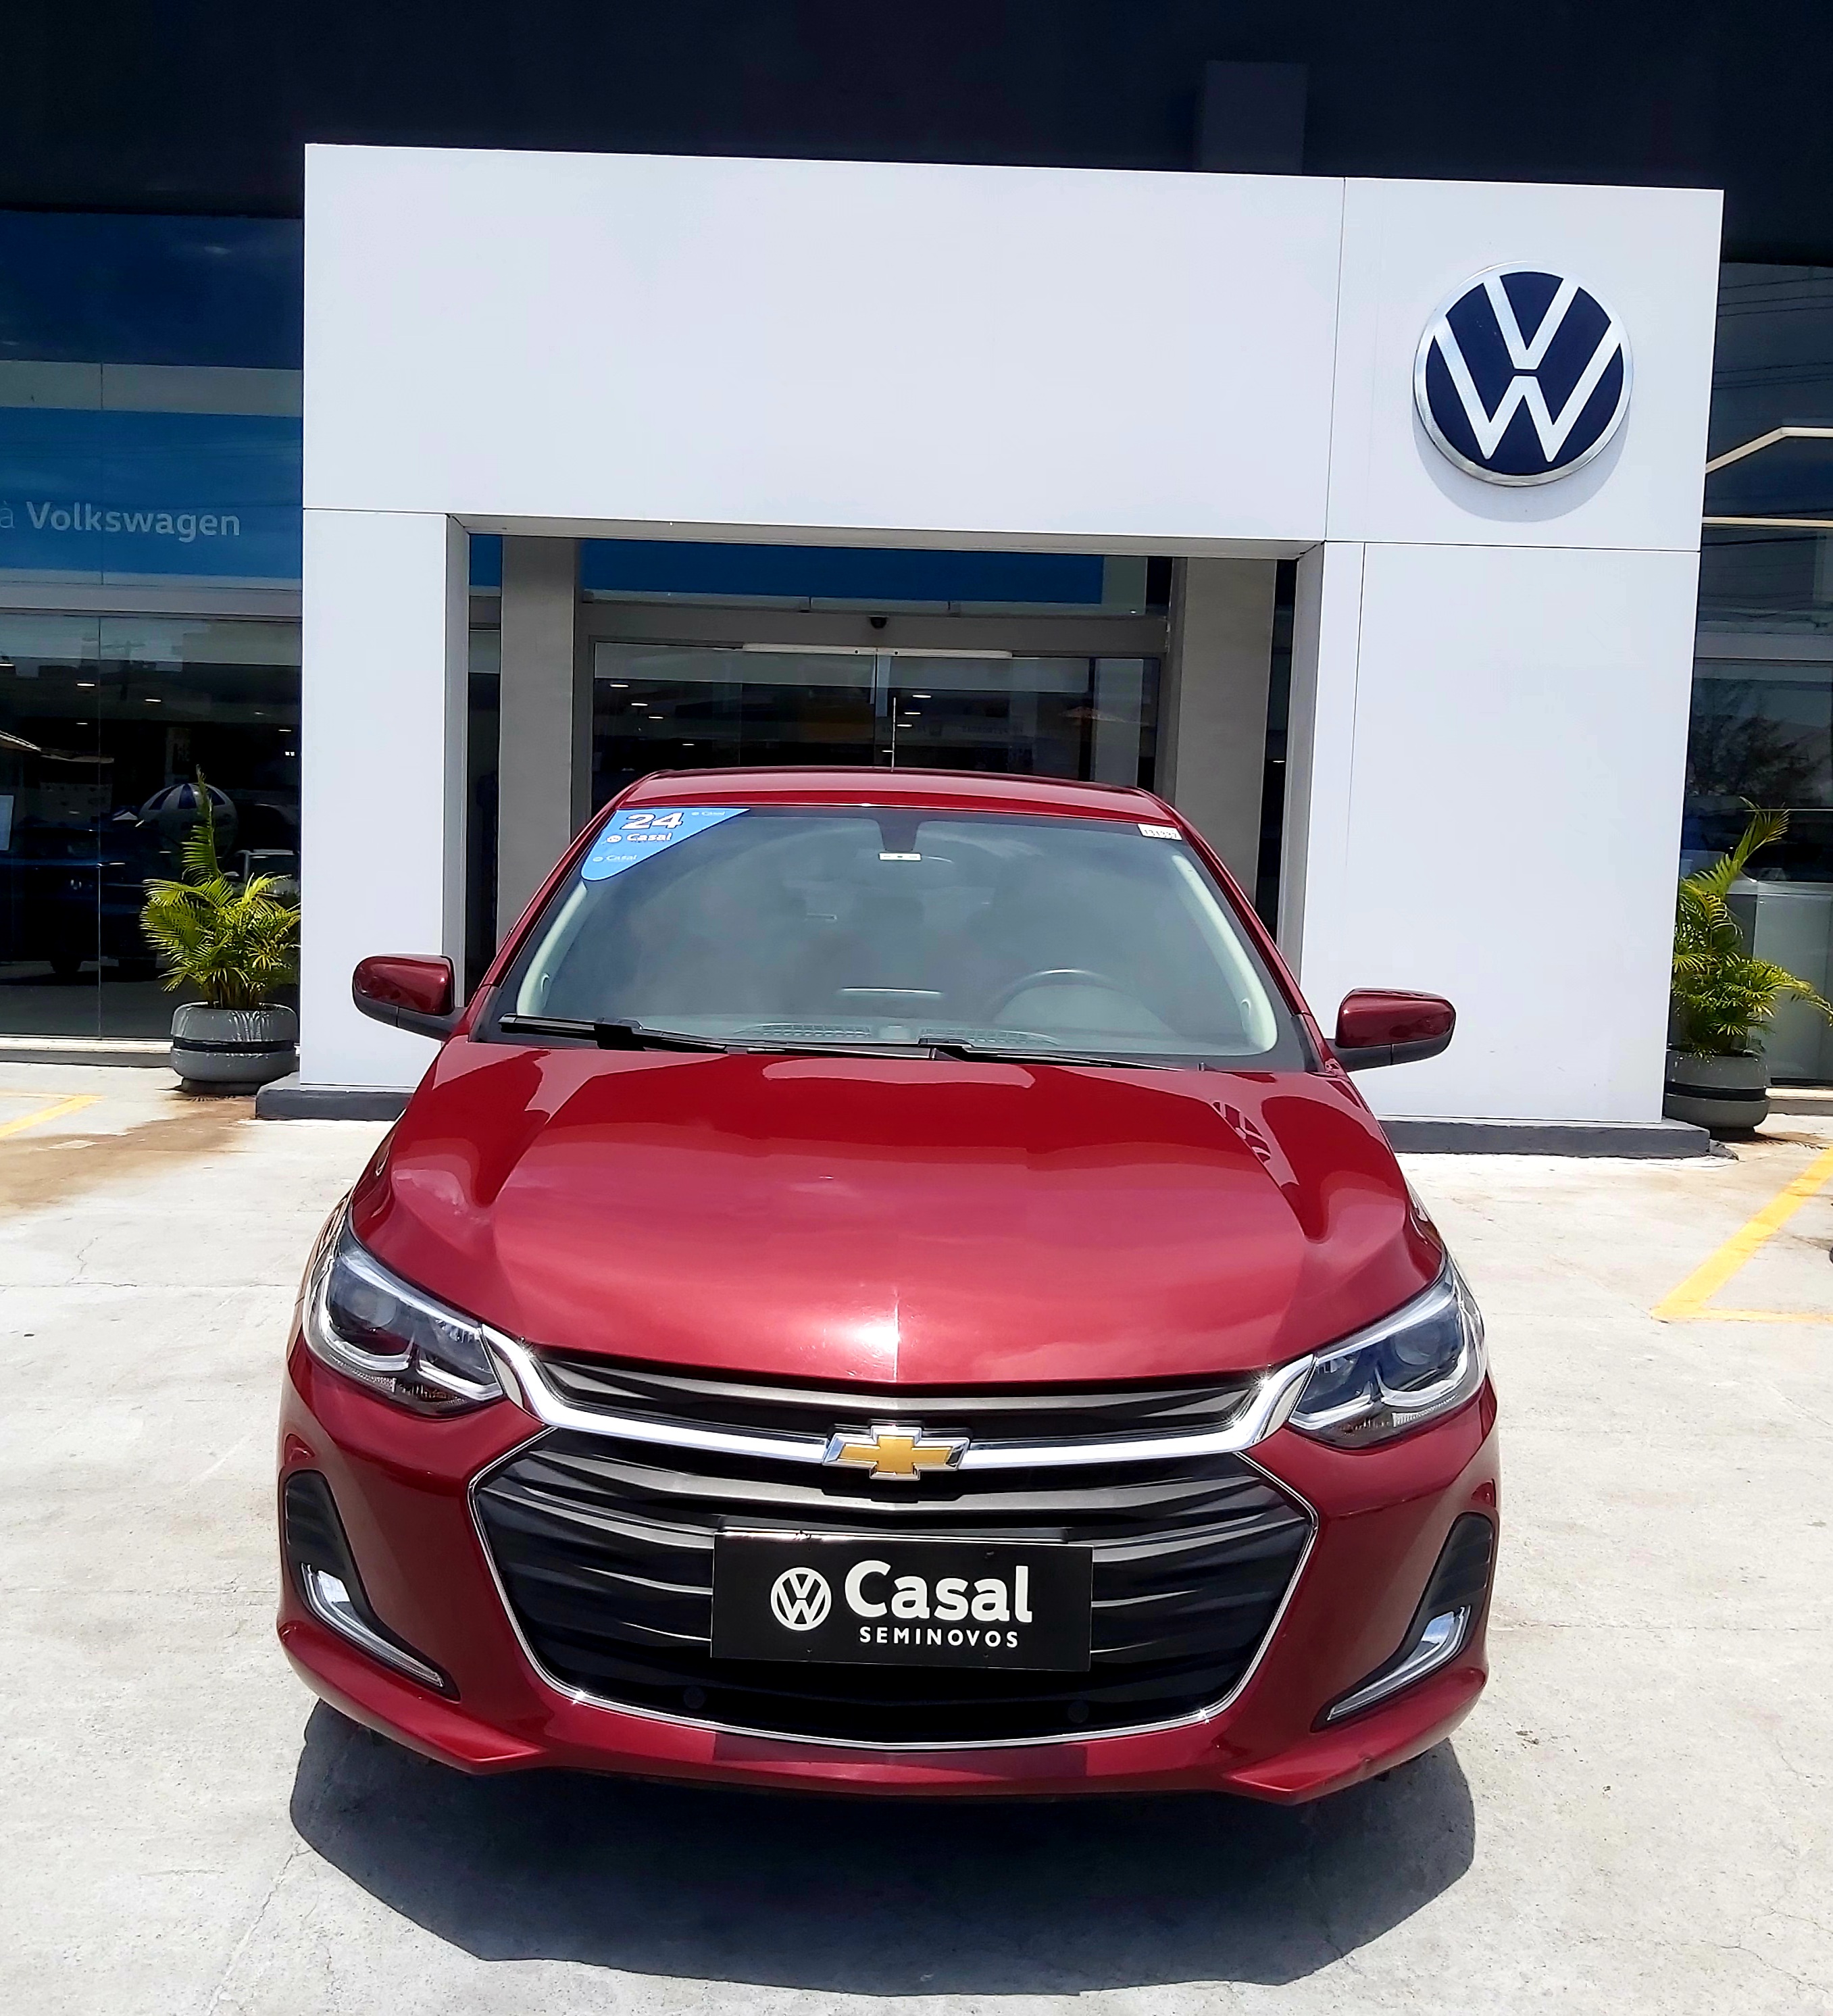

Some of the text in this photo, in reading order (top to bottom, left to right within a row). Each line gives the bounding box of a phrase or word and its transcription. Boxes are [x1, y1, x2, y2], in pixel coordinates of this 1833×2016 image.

[26, 501, 241, 543] Volkswagen
[620, 812, 684, 830] 24
[626, 832, 673, 842] Casal
[845, 1560, 1033, 1623] Casal
[859, 1626, 1019, 1648] SEMINOVOS
